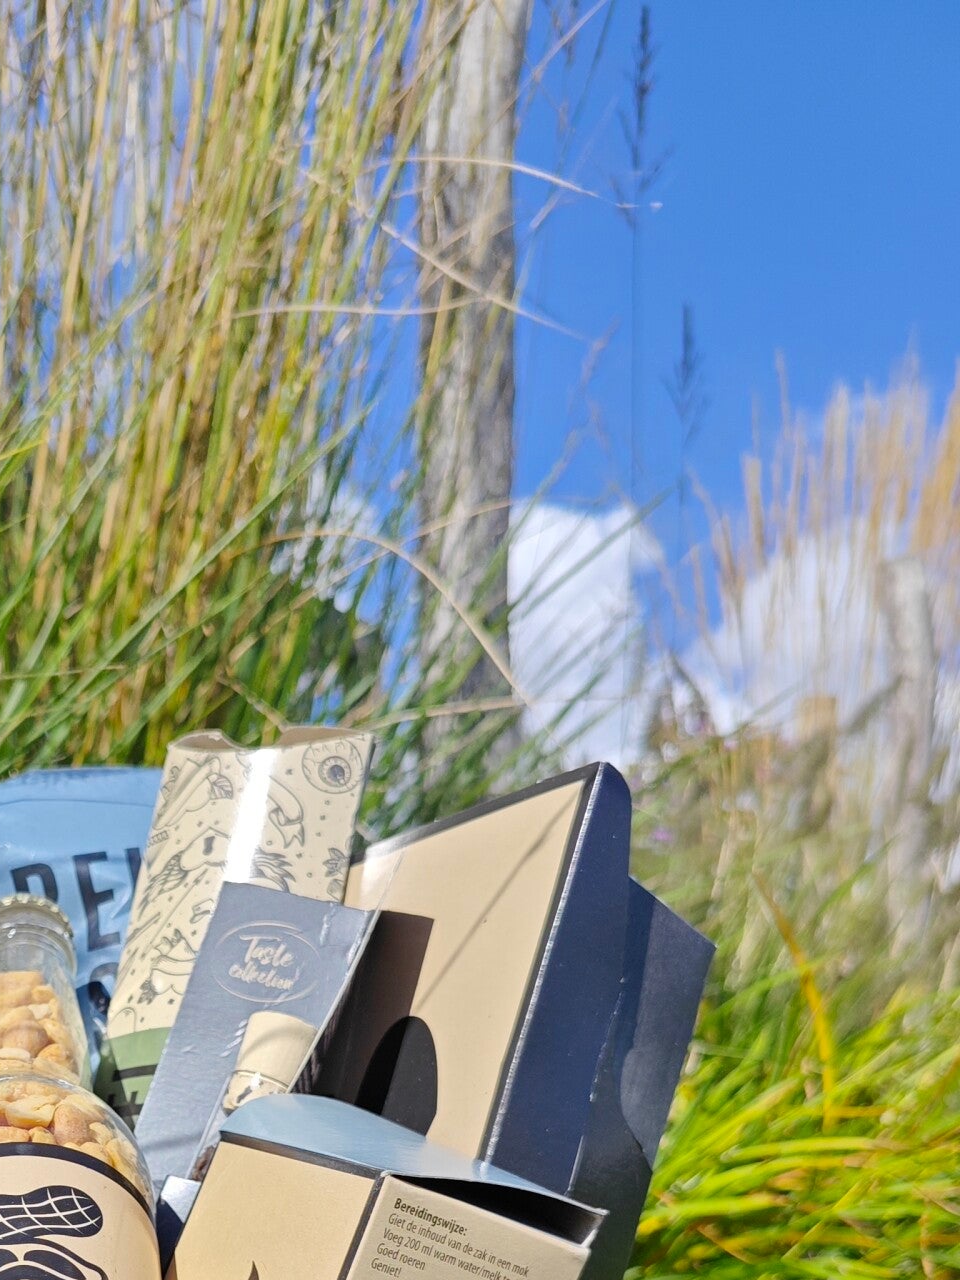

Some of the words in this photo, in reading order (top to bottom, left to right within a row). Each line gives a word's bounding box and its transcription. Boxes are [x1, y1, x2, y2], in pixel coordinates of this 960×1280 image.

[239, 934, 295, 967] Taste
[394, 1198, 468, 1236] Bereidingswijze:
[377, 1243, 398, 1260] Goed
[399, 1252, 426, 1270] roeren
[383, 1228, 403, 1246] Voeg
[404, 1237, 420, 1251] 200
[422, 1243, 432, 1255] ml
[434, 1249, 457, 1265] warm
[389, 1213, 405, 1229] Giet
[407, 1220, 416, 1233] de
[418, 1224, 446, 1244] inhoud
[448, 1238, 461, 1250] van
[462, 1242, 473, 1255] de
[473, 1247, 488, 1261] zak
[489, 1253, 495, 1264] in
[497, 1258, 511, 1269] een
[512, 1264, 529, 1277] mok
[371, 1258, 401, 1278] Geniet!
